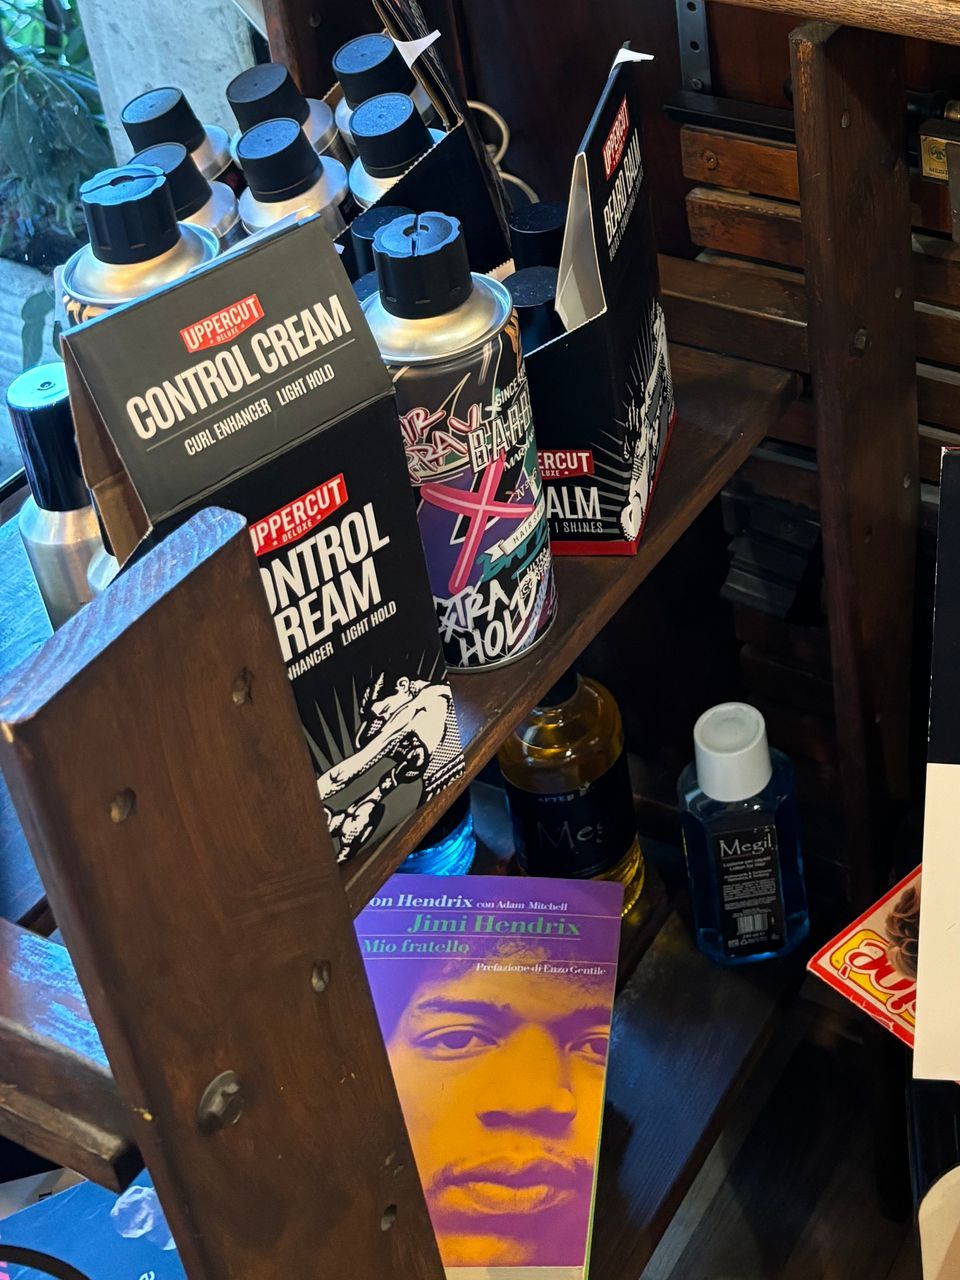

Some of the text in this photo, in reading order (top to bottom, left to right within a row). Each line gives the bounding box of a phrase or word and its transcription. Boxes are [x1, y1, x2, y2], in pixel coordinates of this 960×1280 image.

[603, 169, 630, 247] BEARD
[184, 296, 262, 350] UPPERCUT
[216, 325, 240, 343] DELUXE
[125, 293, 352, 441] CONTROL CREAM
[495, 377, 518, 407] SINCE
[184, 363, 336, 457] CURL ENHANCER LIGHT HOLD
[536, 452, 590, 473] ERCUT
[541, 468, 561, 477] LUXE
[546, 485, 602, 520] ALM
[282, 518, 313, 544] DELUXE
[563, 521, 605, 534] SHINES
[259, 502, 391, 613] ONTROL
[273, 556, 383, 663] REAM
[341, 617, 370, 648] LIGHT
[370, 599, 398, 630] HOLD
[369, 893, 568, 911] on Hendrix con Adam Mitchell
[407, 913, 582, 937] Jimi Hendrix
[363, 938, 471, 955] Mio fratello
[476, 961, 607, 977] Prefazione di Enzo Gentile
